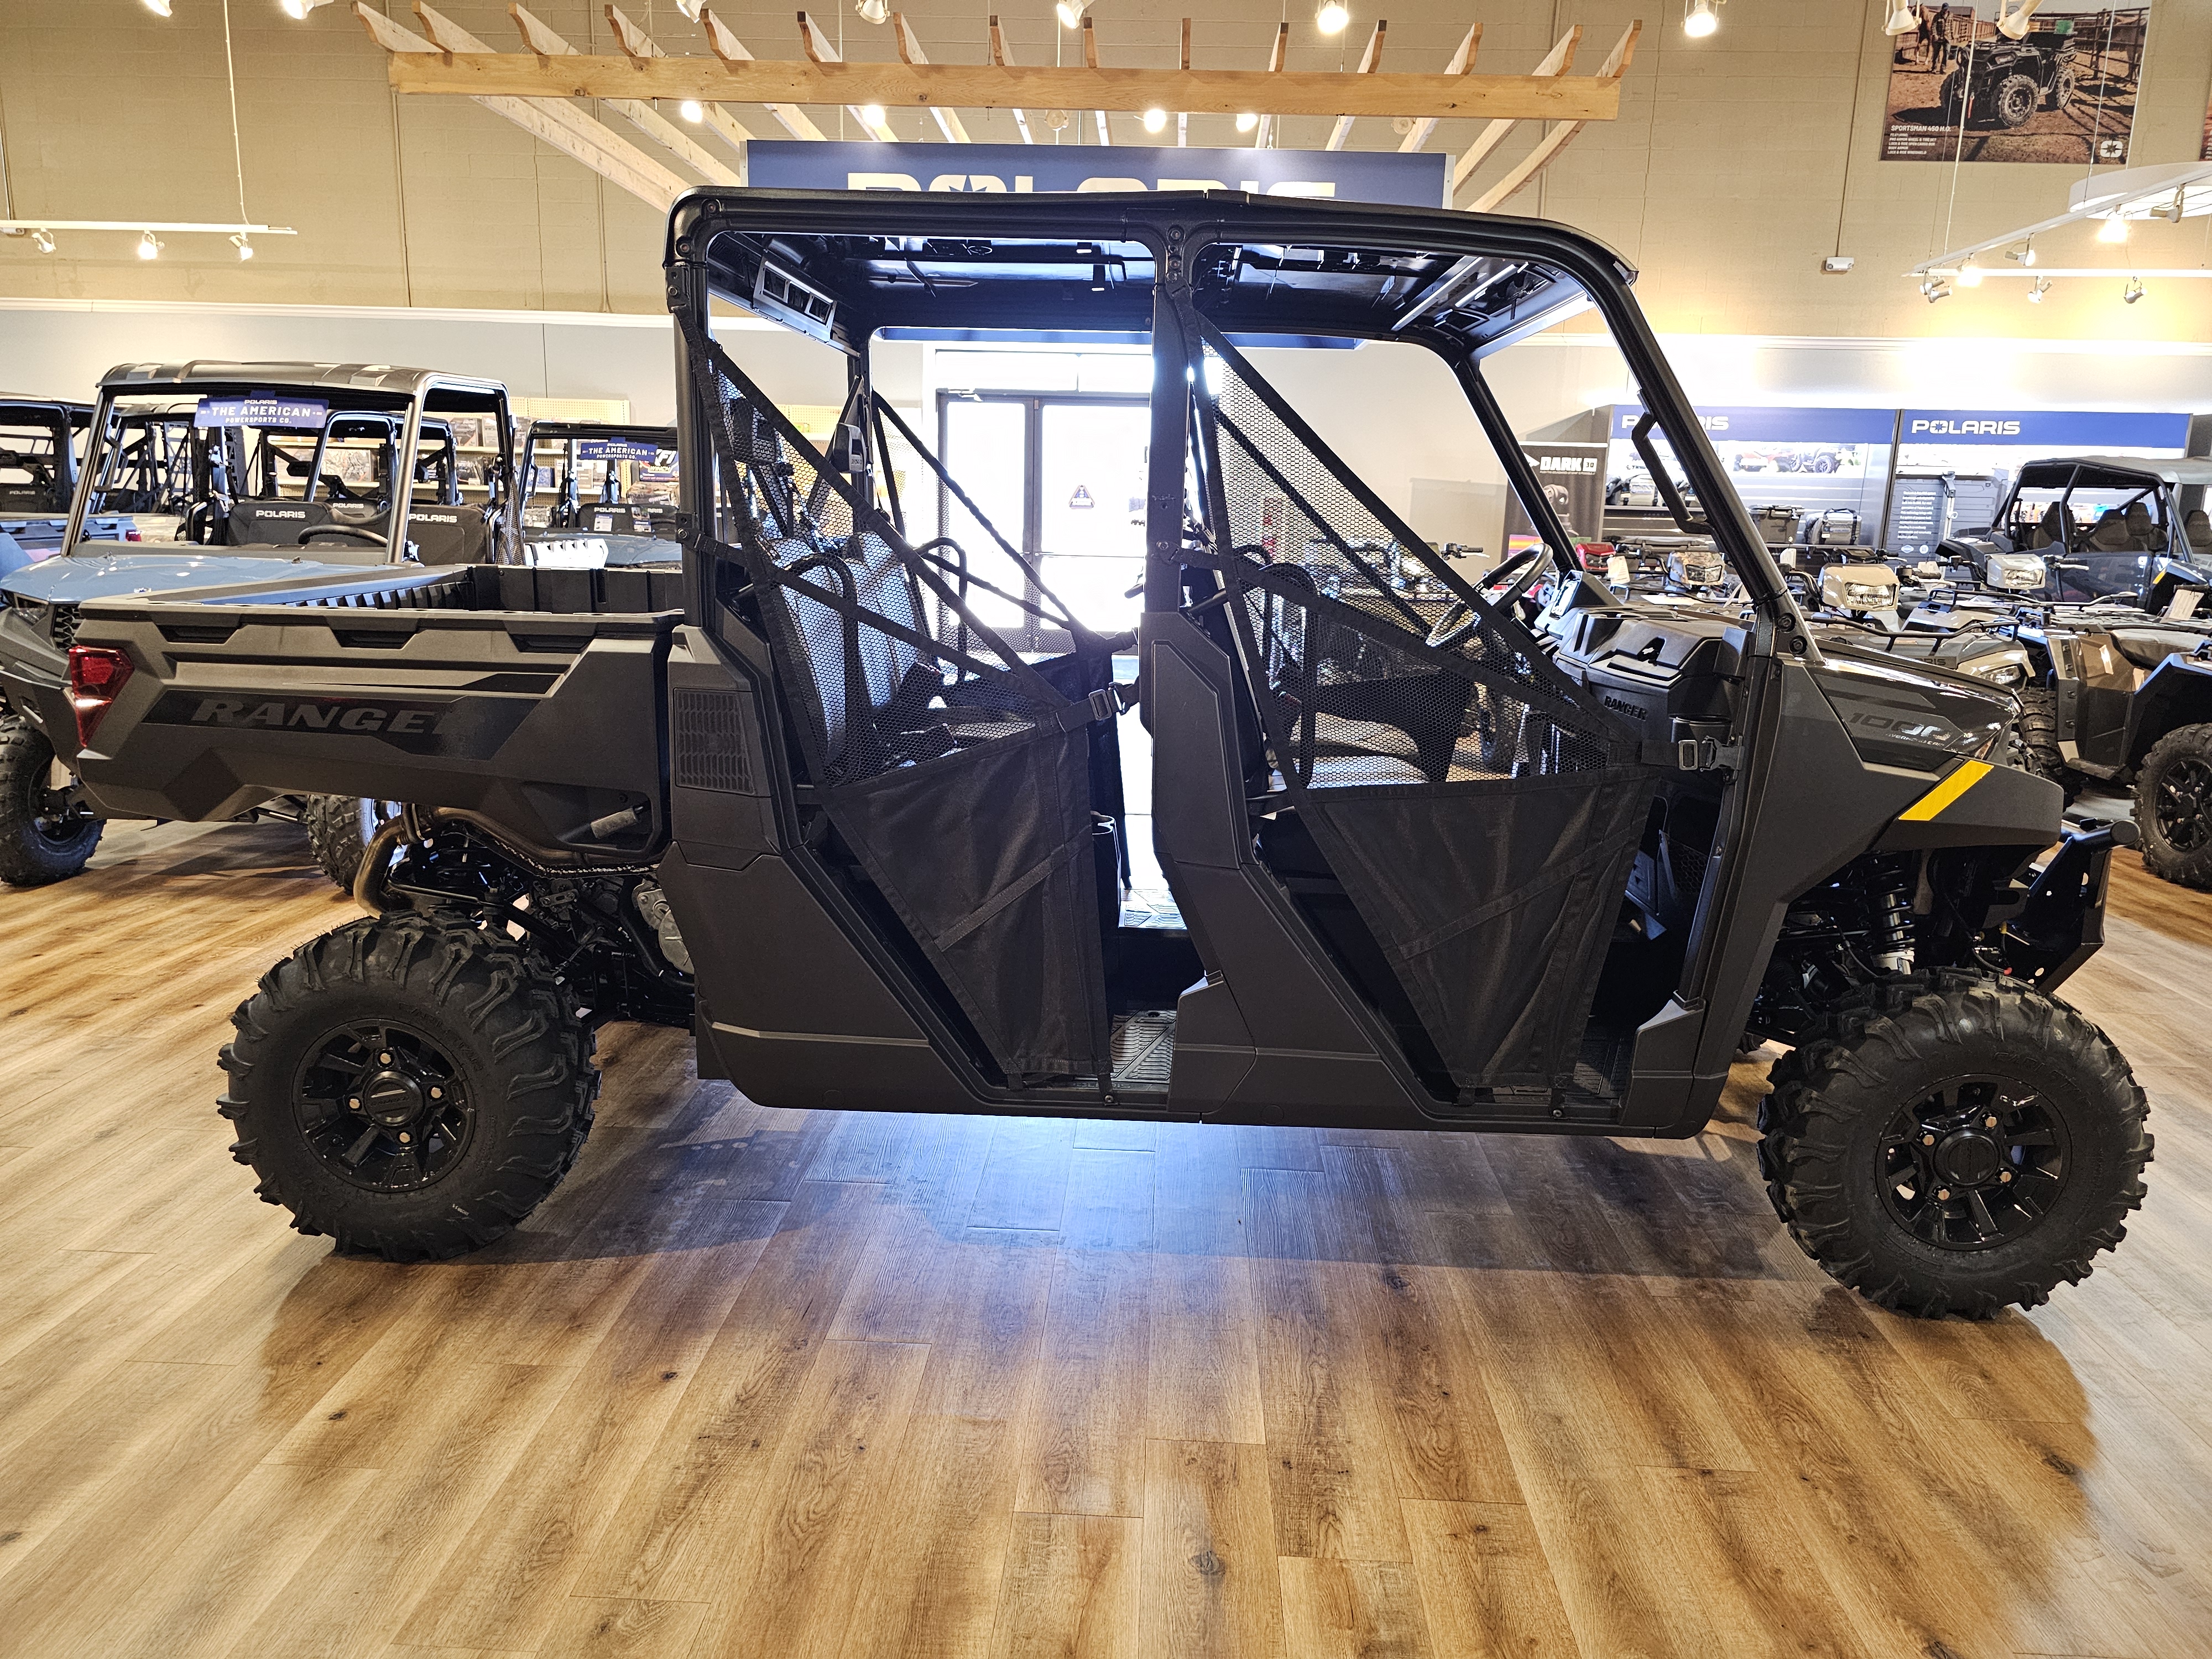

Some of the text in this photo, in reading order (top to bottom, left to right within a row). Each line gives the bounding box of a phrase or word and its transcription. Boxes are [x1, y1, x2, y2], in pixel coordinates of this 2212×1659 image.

[212, 406, 311, 417] THE AMERICAN
[1911, 420, 2020, 435] POLARIS
[605, 447, 648, 456] AMERICAN
[1540, 456, 1582, 472] DARK
[255, 510, 306, 519] POLARIS
[408, 513, 458, 523] POLARIS
[1604, 695, 1648, 722] RANGER
